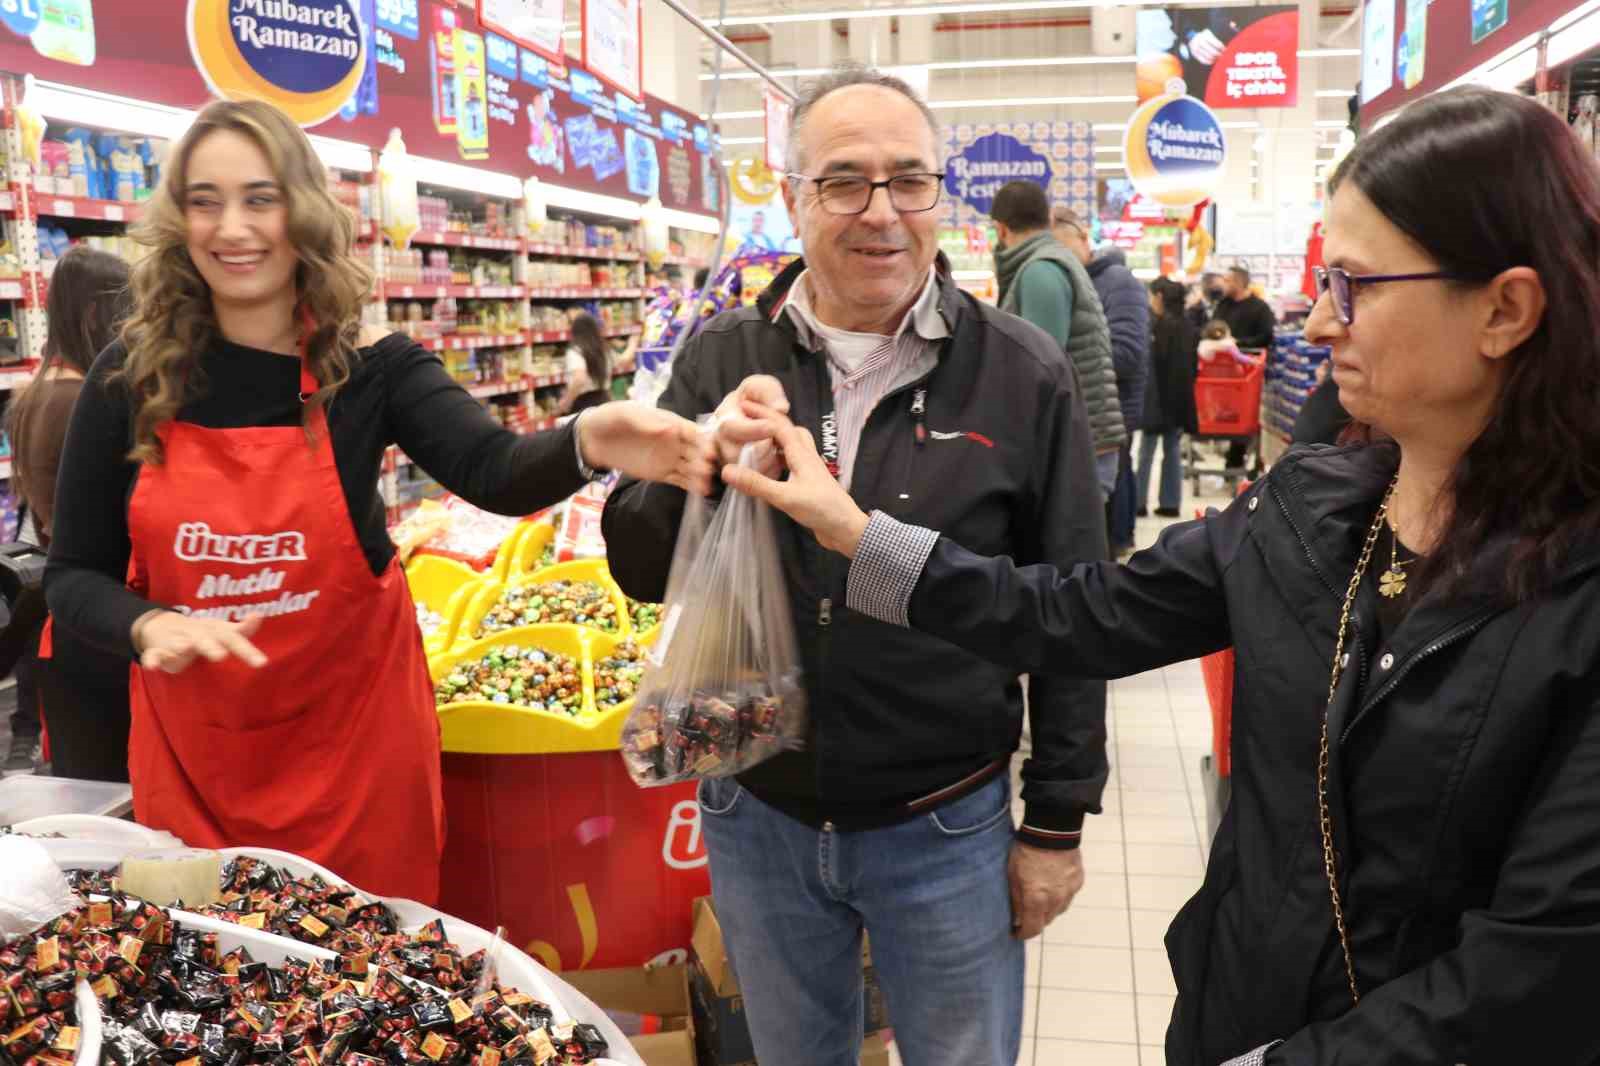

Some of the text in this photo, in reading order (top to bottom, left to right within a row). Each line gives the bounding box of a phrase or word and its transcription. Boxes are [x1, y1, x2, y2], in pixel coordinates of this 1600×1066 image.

[233, 16, 358, 59] Ramazan
[949, 158, 1046, 180] Ramazan
[1148, 139, 1224, 164] Ramazan
[821, 411, 838, 459] TOMMY
[174, 522, 307, 564] ÜLKER
[196, 567, 286, 599] Mutlu
